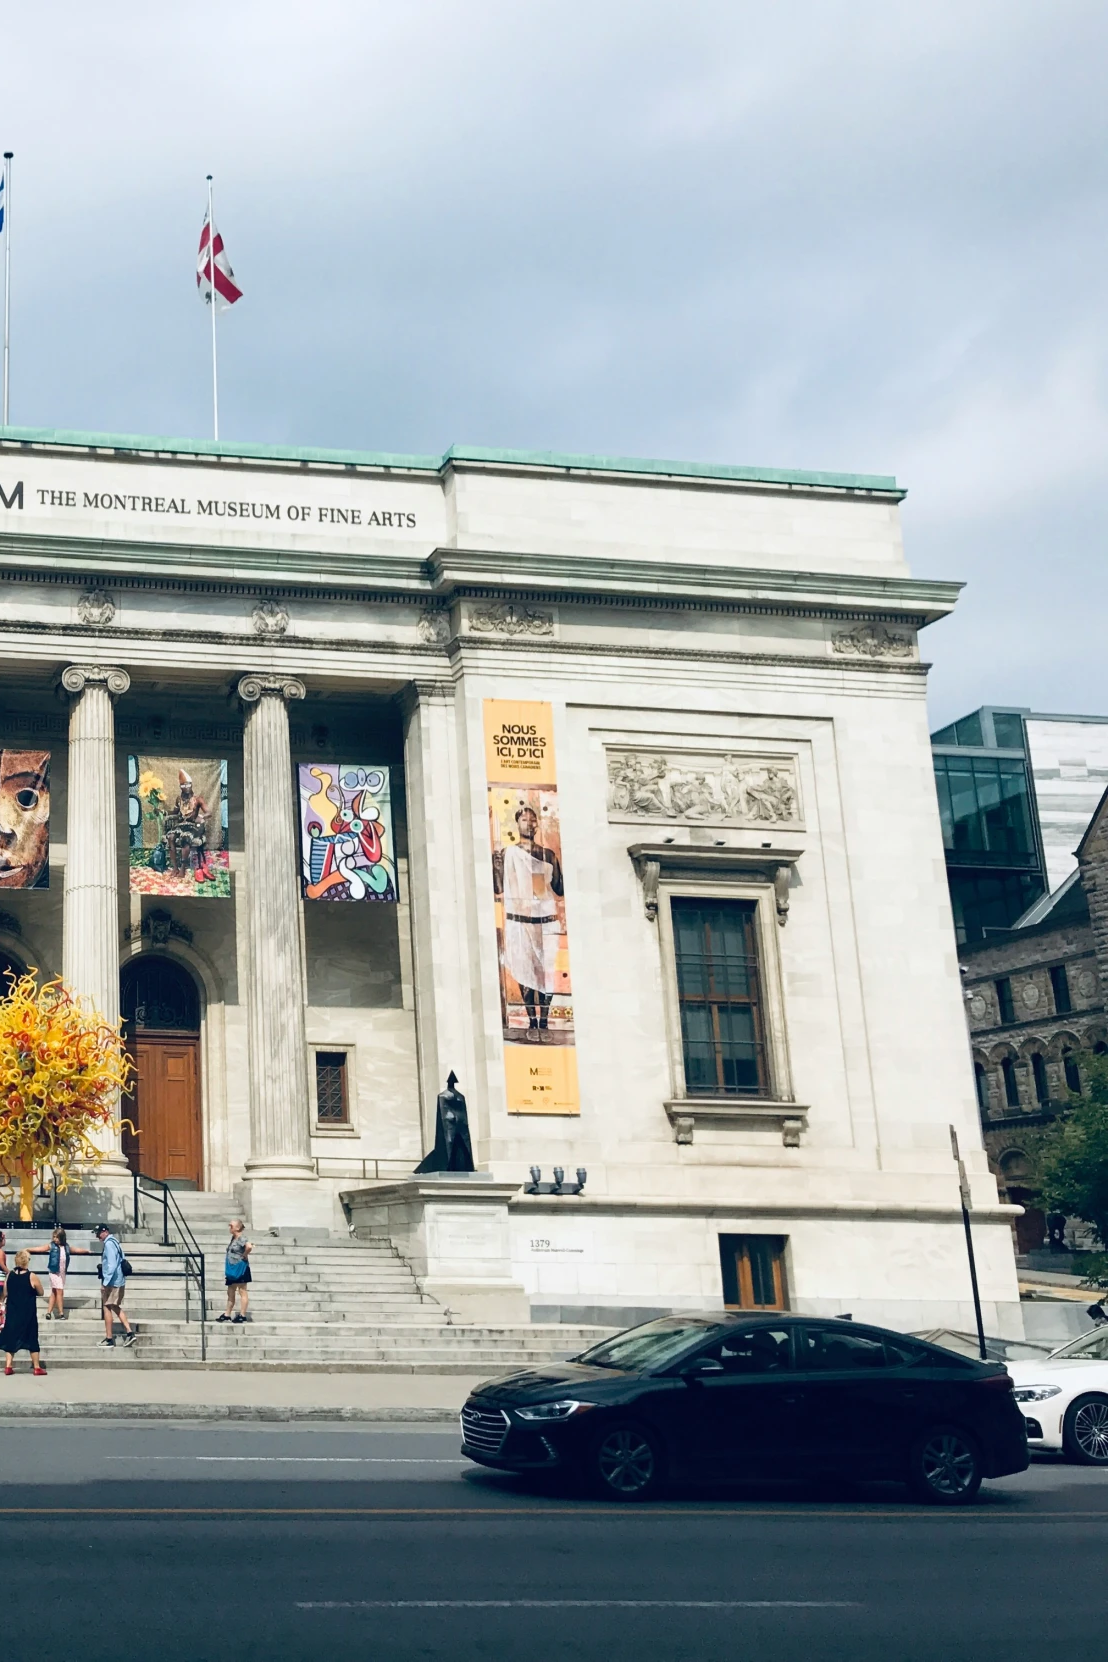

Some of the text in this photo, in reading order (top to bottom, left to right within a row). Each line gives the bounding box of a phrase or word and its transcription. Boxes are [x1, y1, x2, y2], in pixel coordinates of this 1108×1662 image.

[36, 489, 417, 528] THE MONTREAL MUSEUM OF FINE ARTS
[501, 724, 537, 735] NOUS
[493, 735, 547, 747] SOMMES
[496, 746, 544, 758] ICI, D'ICI
[530, 1239, 551, 1248] 1379
